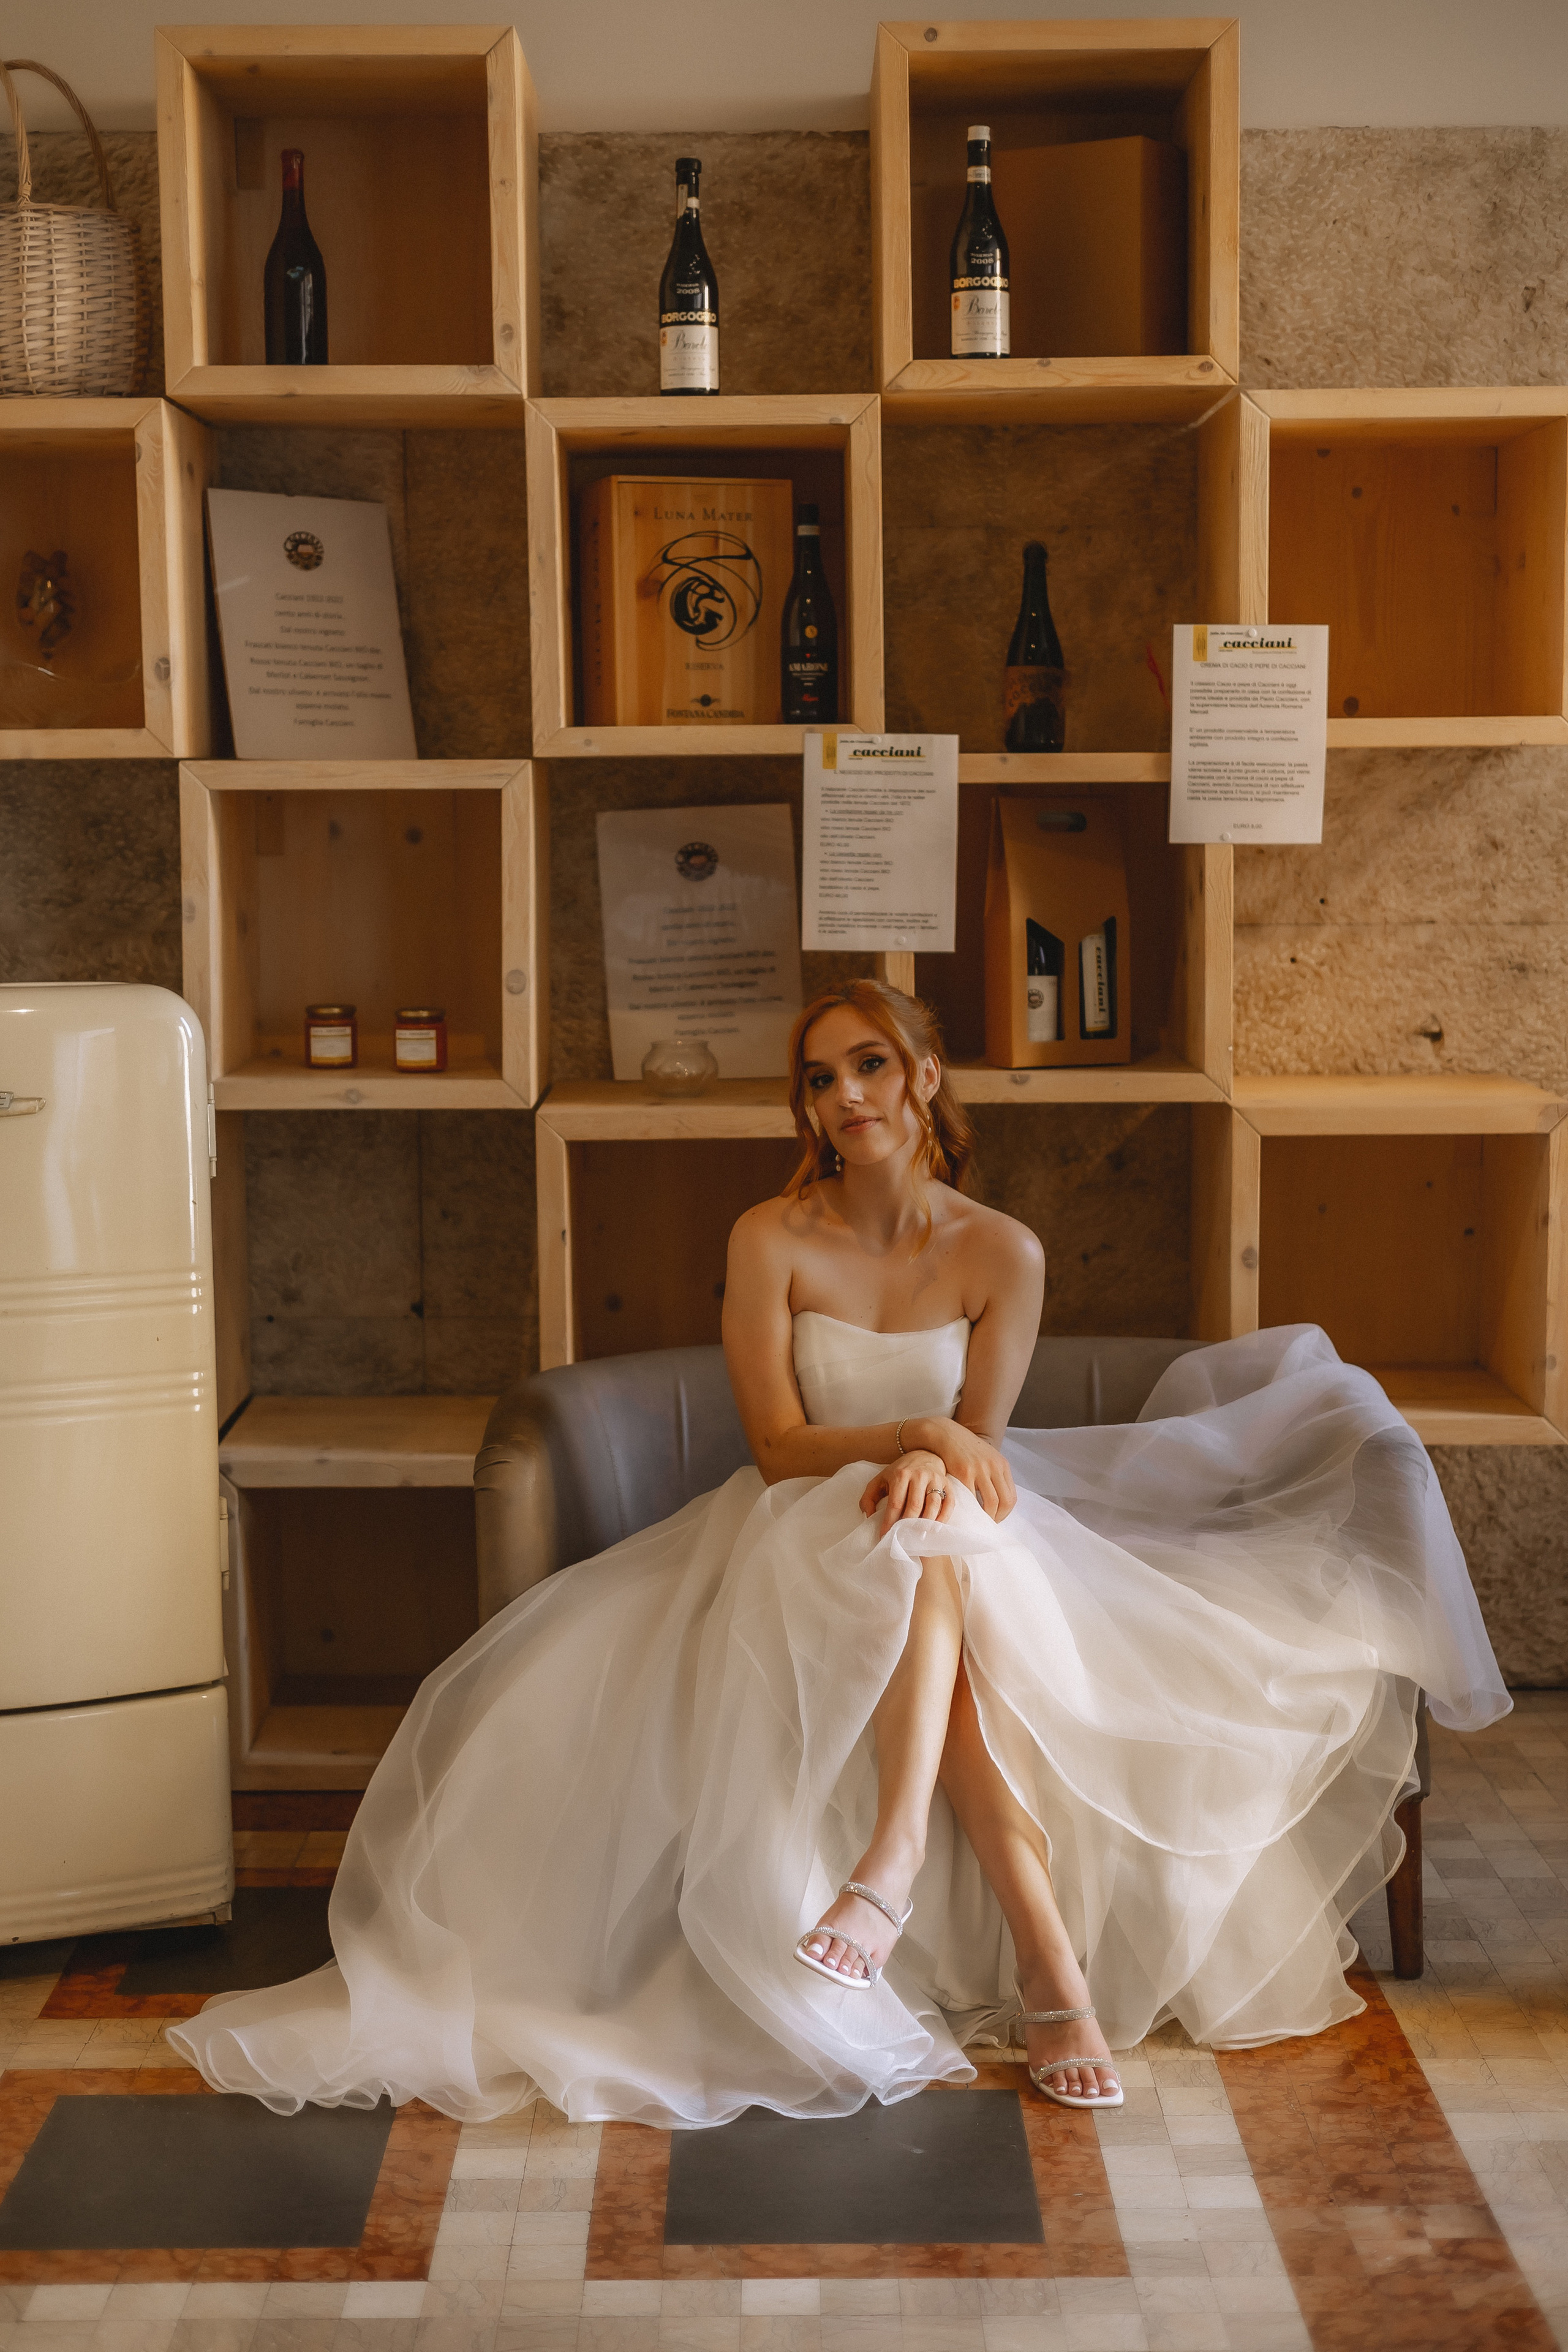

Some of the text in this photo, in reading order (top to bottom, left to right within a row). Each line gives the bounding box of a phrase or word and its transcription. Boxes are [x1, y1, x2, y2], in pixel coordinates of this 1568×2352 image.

[1223, 637, 1292, 648] cacciani
[853, 746, 921, 757] cacciani
[1096, 946, 1106, 1012] cacciani
